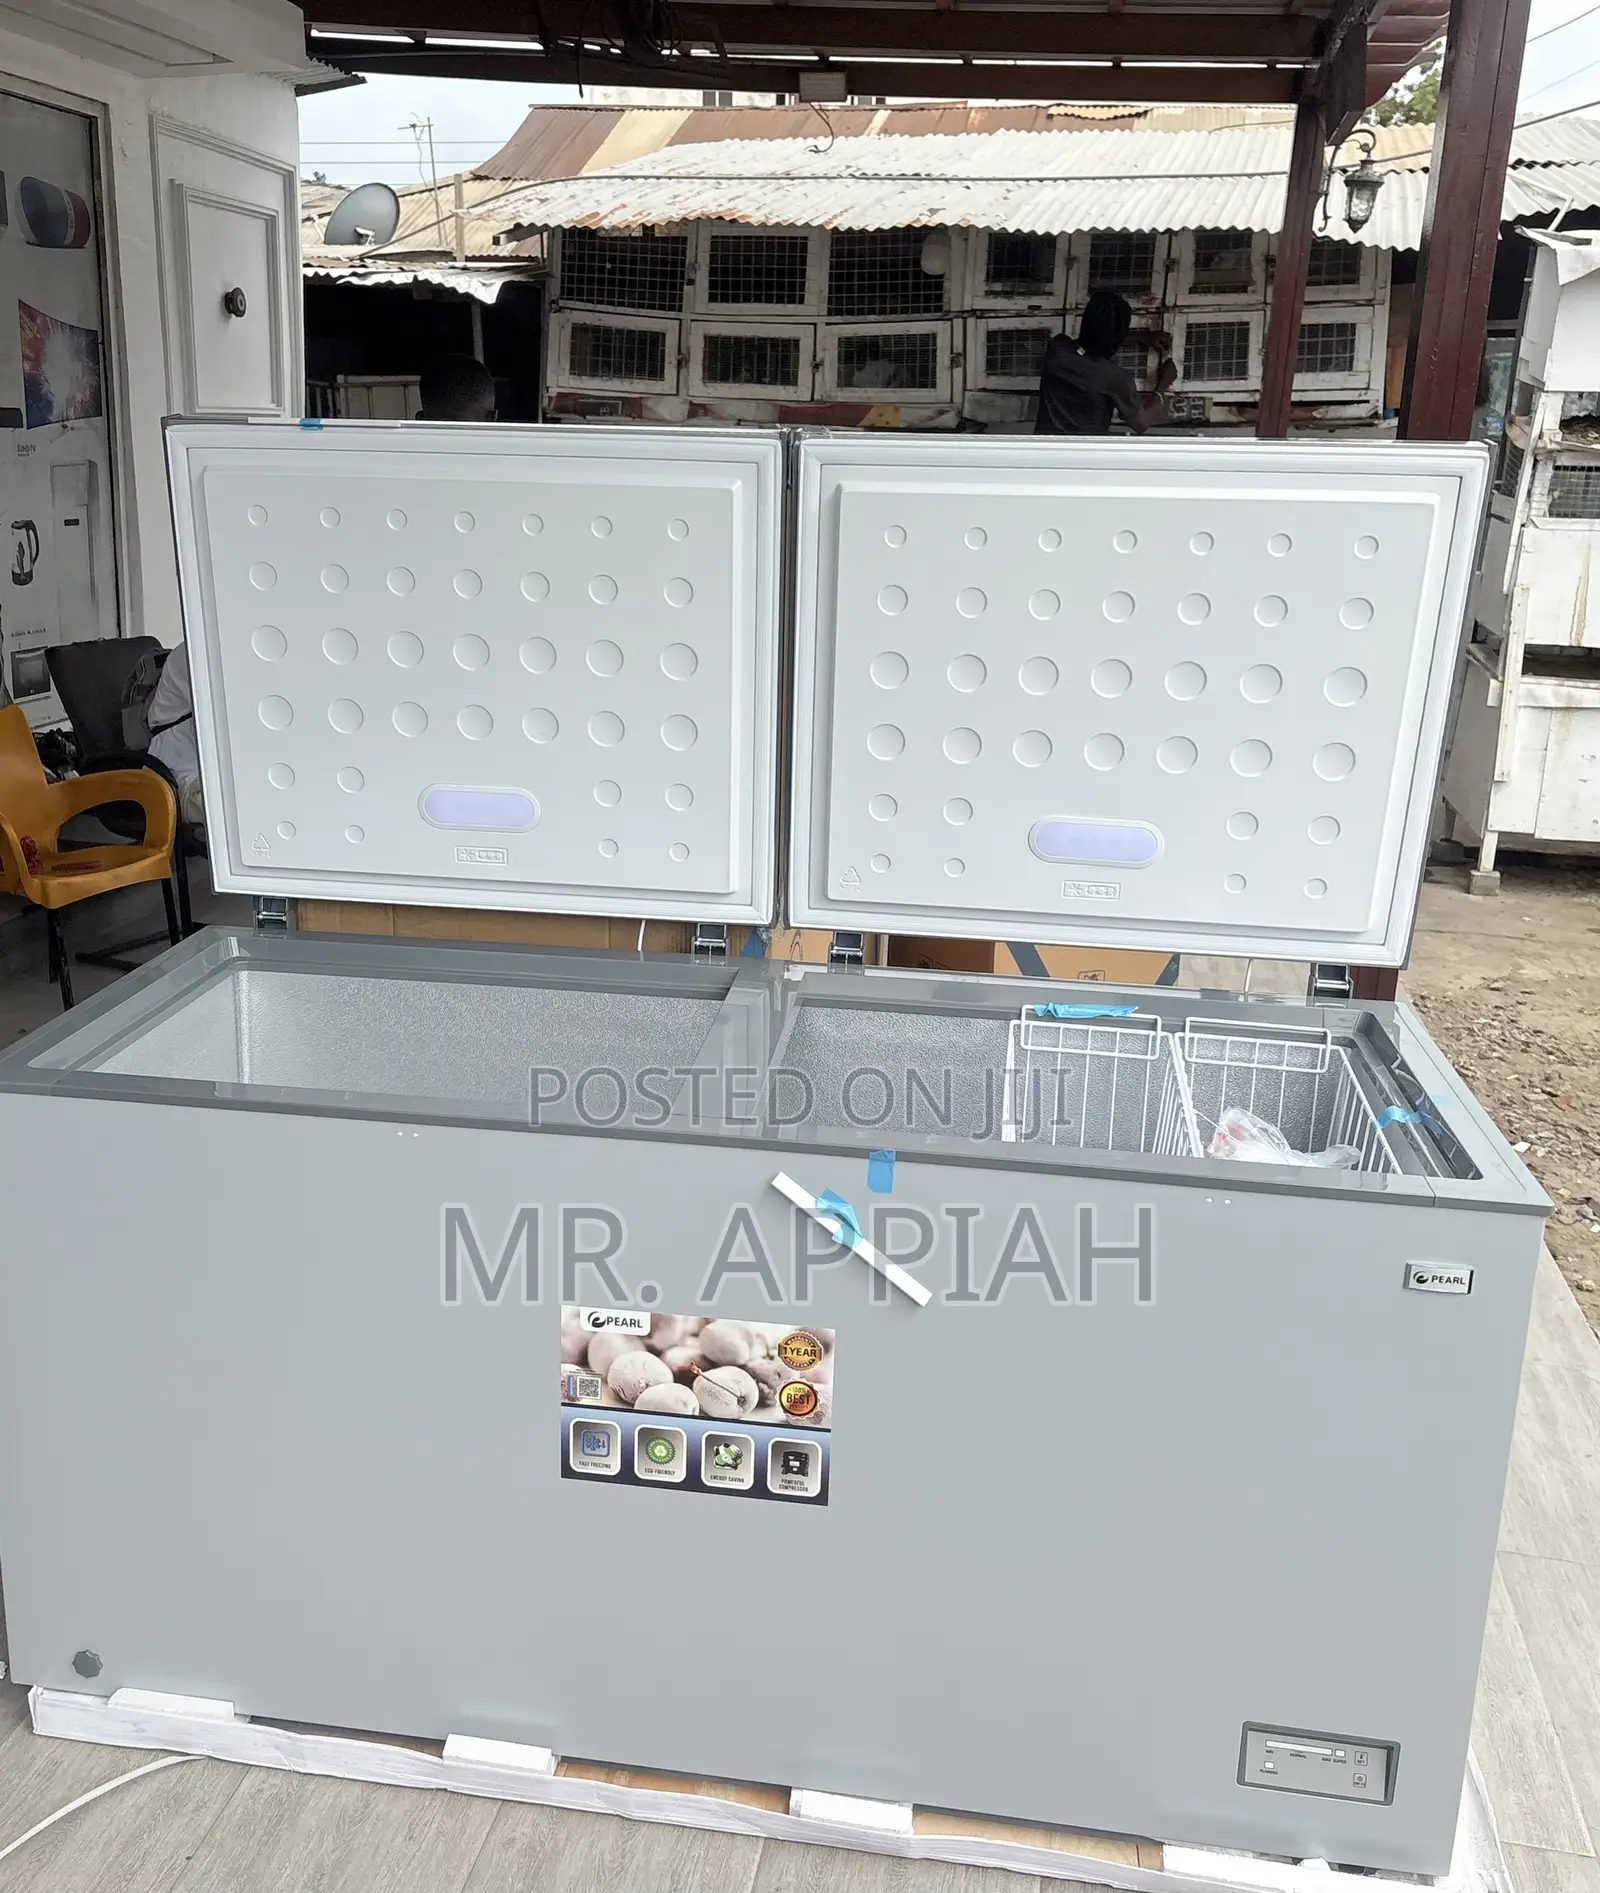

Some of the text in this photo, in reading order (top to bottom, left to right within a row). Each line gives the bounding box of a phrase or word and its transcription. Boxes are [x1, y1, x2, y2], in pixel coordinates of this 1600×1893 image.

[1431, 1274, 1467, 1285] PEARL
[606, 1315, 644, 1329] PEARL
[783, 1346, 817, 1357] 1 YEAR
[787, 1393, 810, 1404] BEST
[590, 1461, 611, 1469] FREEZING
[780, 1478, 805, 1486] POWERFUL
